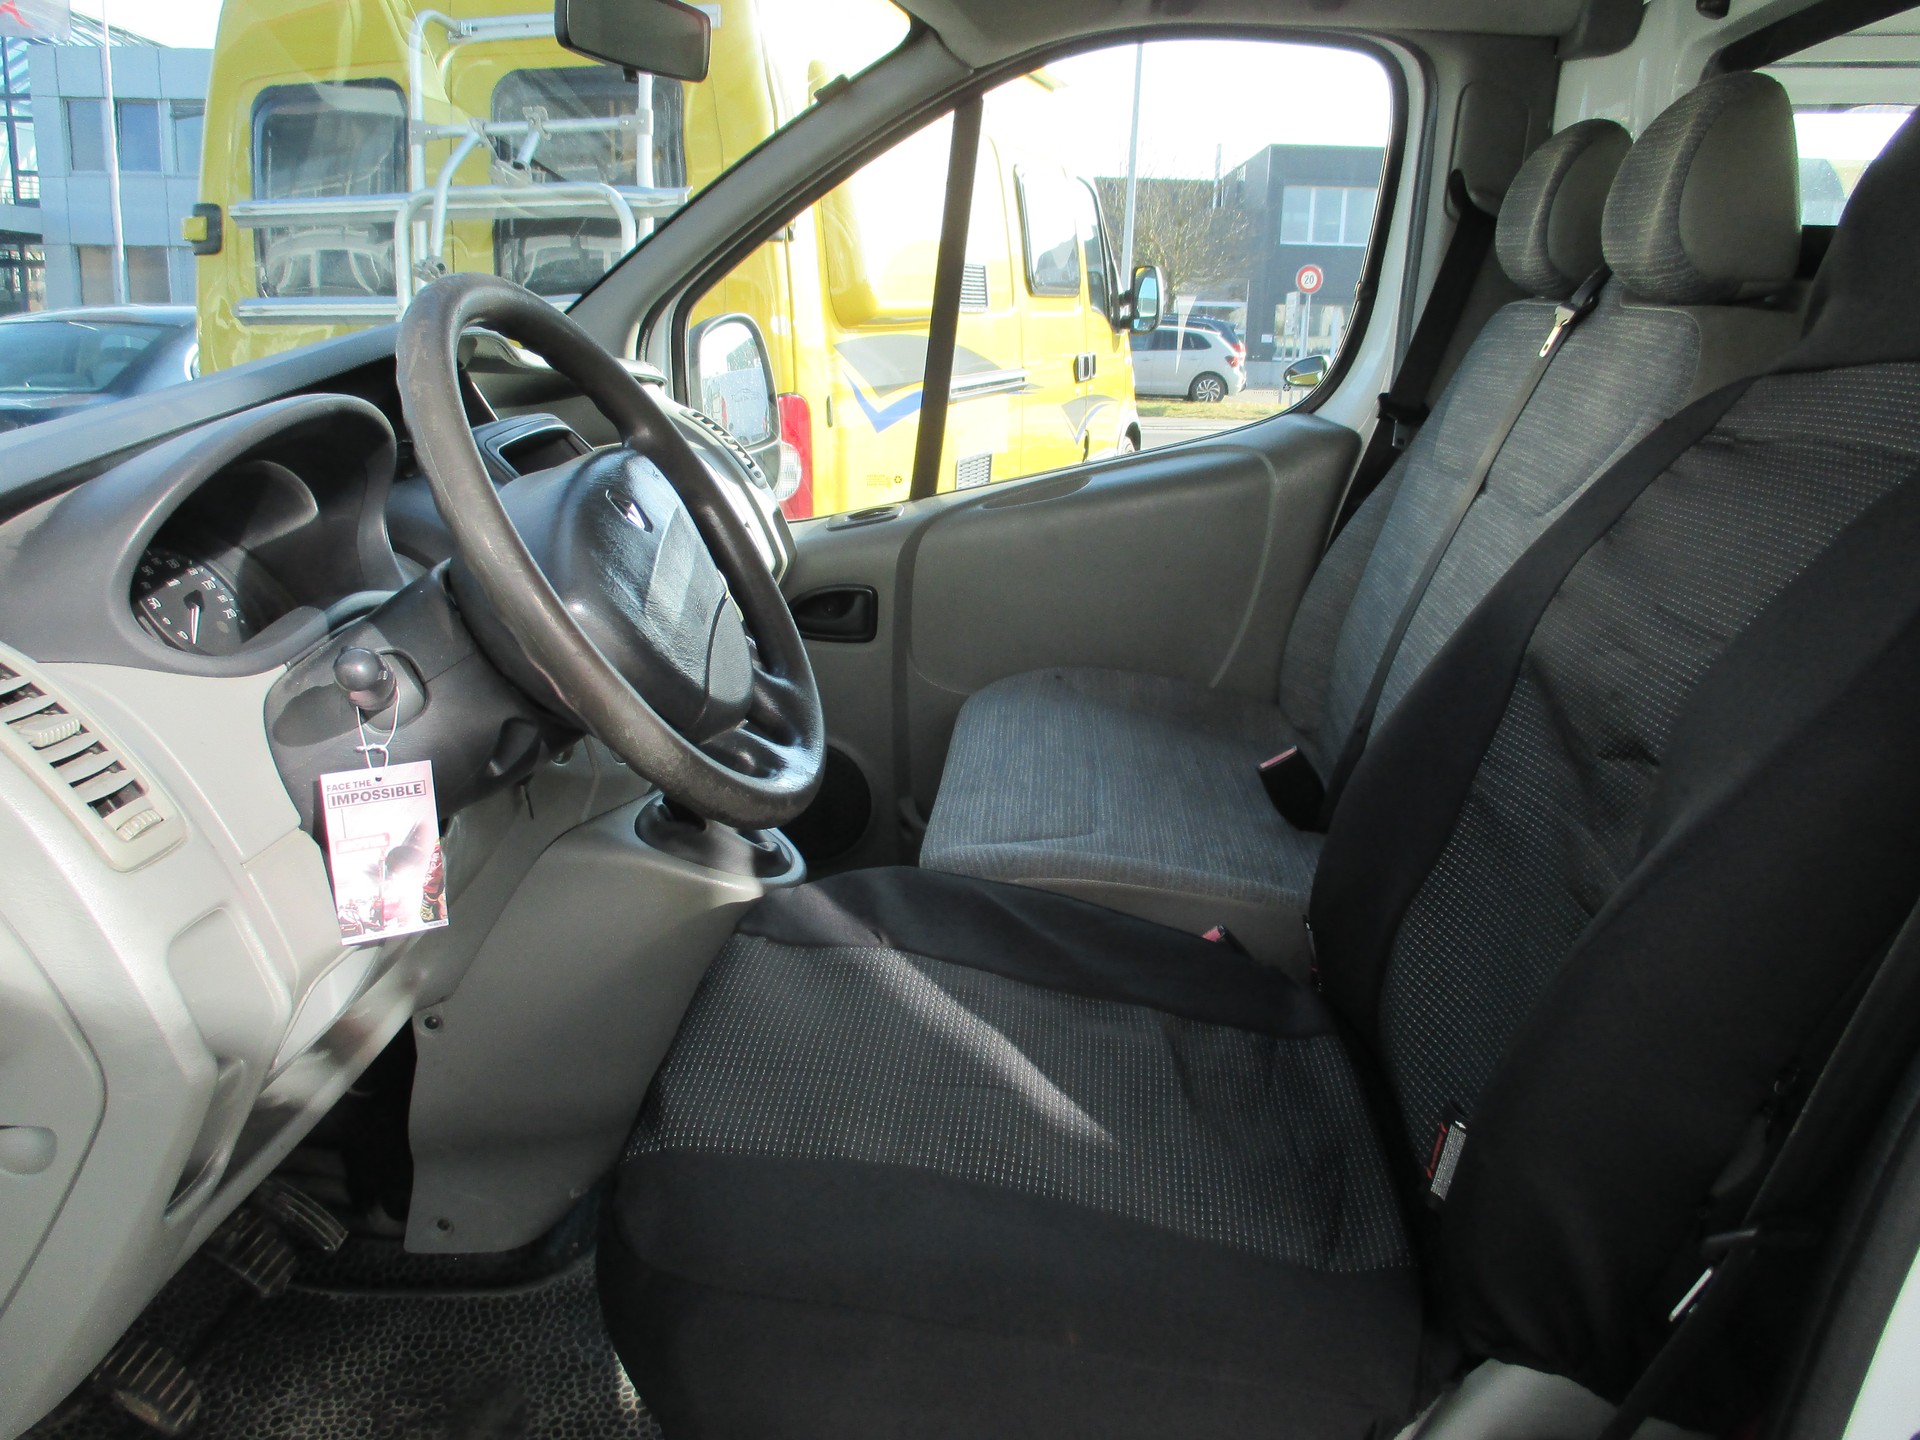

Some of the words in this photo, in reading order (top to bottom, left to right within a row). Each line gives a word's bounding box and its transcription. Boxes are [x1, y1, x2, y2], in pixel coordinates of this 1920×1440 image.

[1304, 275, 1314, 285] 20
[326, 781, 351, 793] FACE
[353, 779, 372, 789] THE
[331, 783, 422, 807] IMPOSSIBLE
